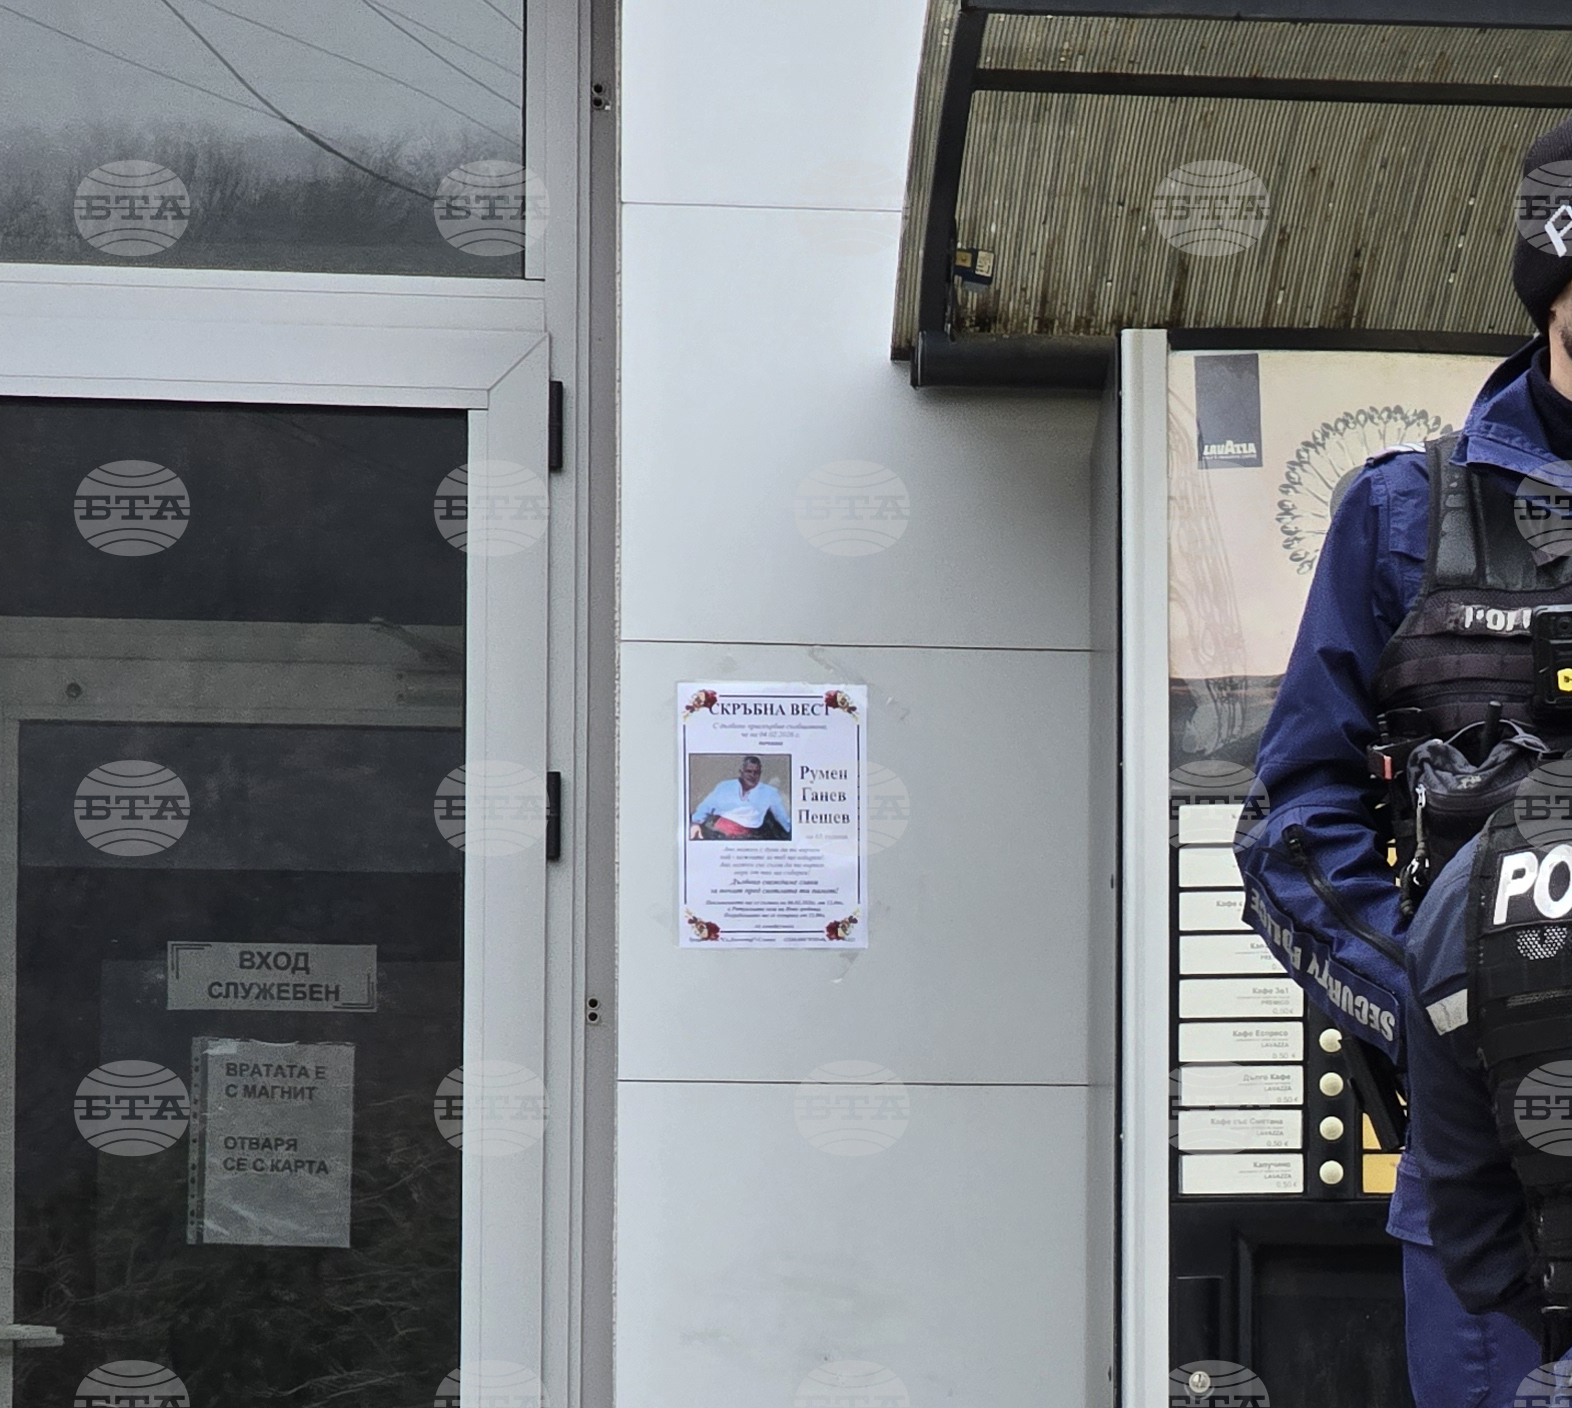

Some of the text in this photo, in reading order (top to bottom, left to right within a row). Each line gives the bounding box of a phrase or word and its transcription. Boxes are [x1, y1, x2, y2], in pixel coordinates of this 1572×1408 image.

[1203, 440, 1257, 456] LAVAZZA
[709, 702, 786, 716] СКРЪБНА
[800, 765, 848, 785] Румен
[802, 787, 847, 802] Ганев
[798, 809, 851, 824] Пешев
[239, 950, 311, 975] ВХОД
[207, 981, 341, 1002] СЛУЖЕБЕН
[1232, 1030, 1253, 1038] Кафе
[225, 1062, 327, 1080] ВРАТАТА Е
[1270, 1073, 1291, 1081] Кафе
[225, 1083, 319, 1101] С МАГНИТ
[223, 1136, 299, 1152] ОТВАРЯ
[222, 1157, 329, 1175] СЕ С КАРТА
